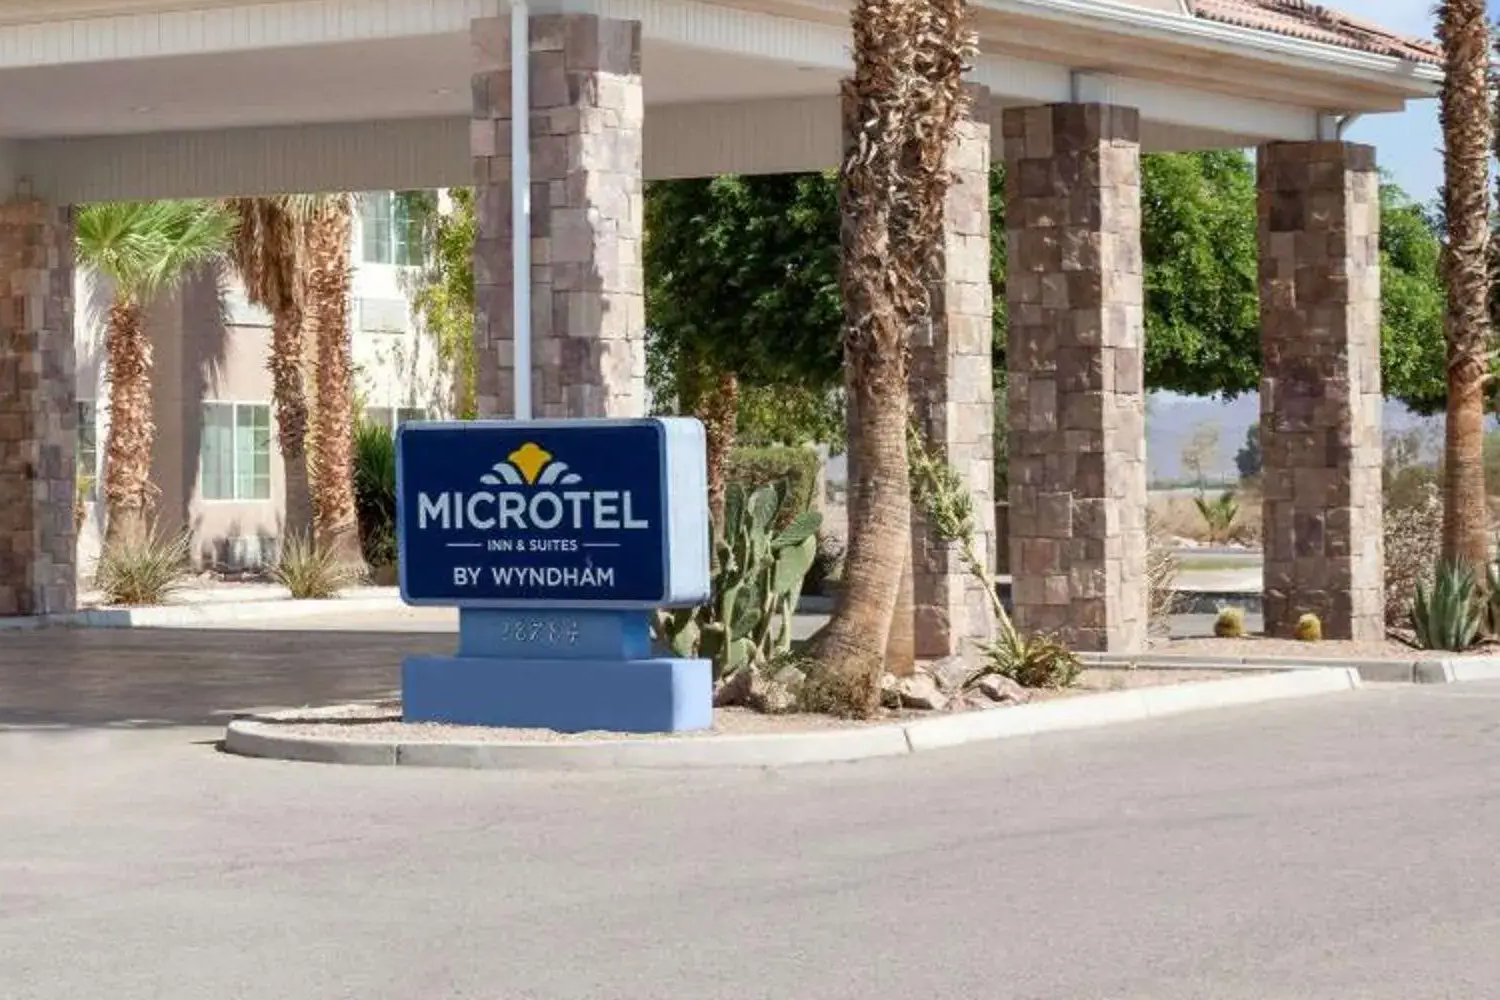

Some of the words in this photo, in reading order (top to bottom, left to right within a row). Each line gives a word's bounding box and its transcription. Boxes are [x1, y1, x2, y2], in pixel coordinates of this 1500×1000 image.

[418, 491, 649, 530] MICROTEL
[487, 539, 513, 551] INN
[516, 539, 525, 551] &
[529, 539, 579, 551] SUITES
[453, 567, 482, 586] BY
[491, 567, 615, 586] WYNDHAM
